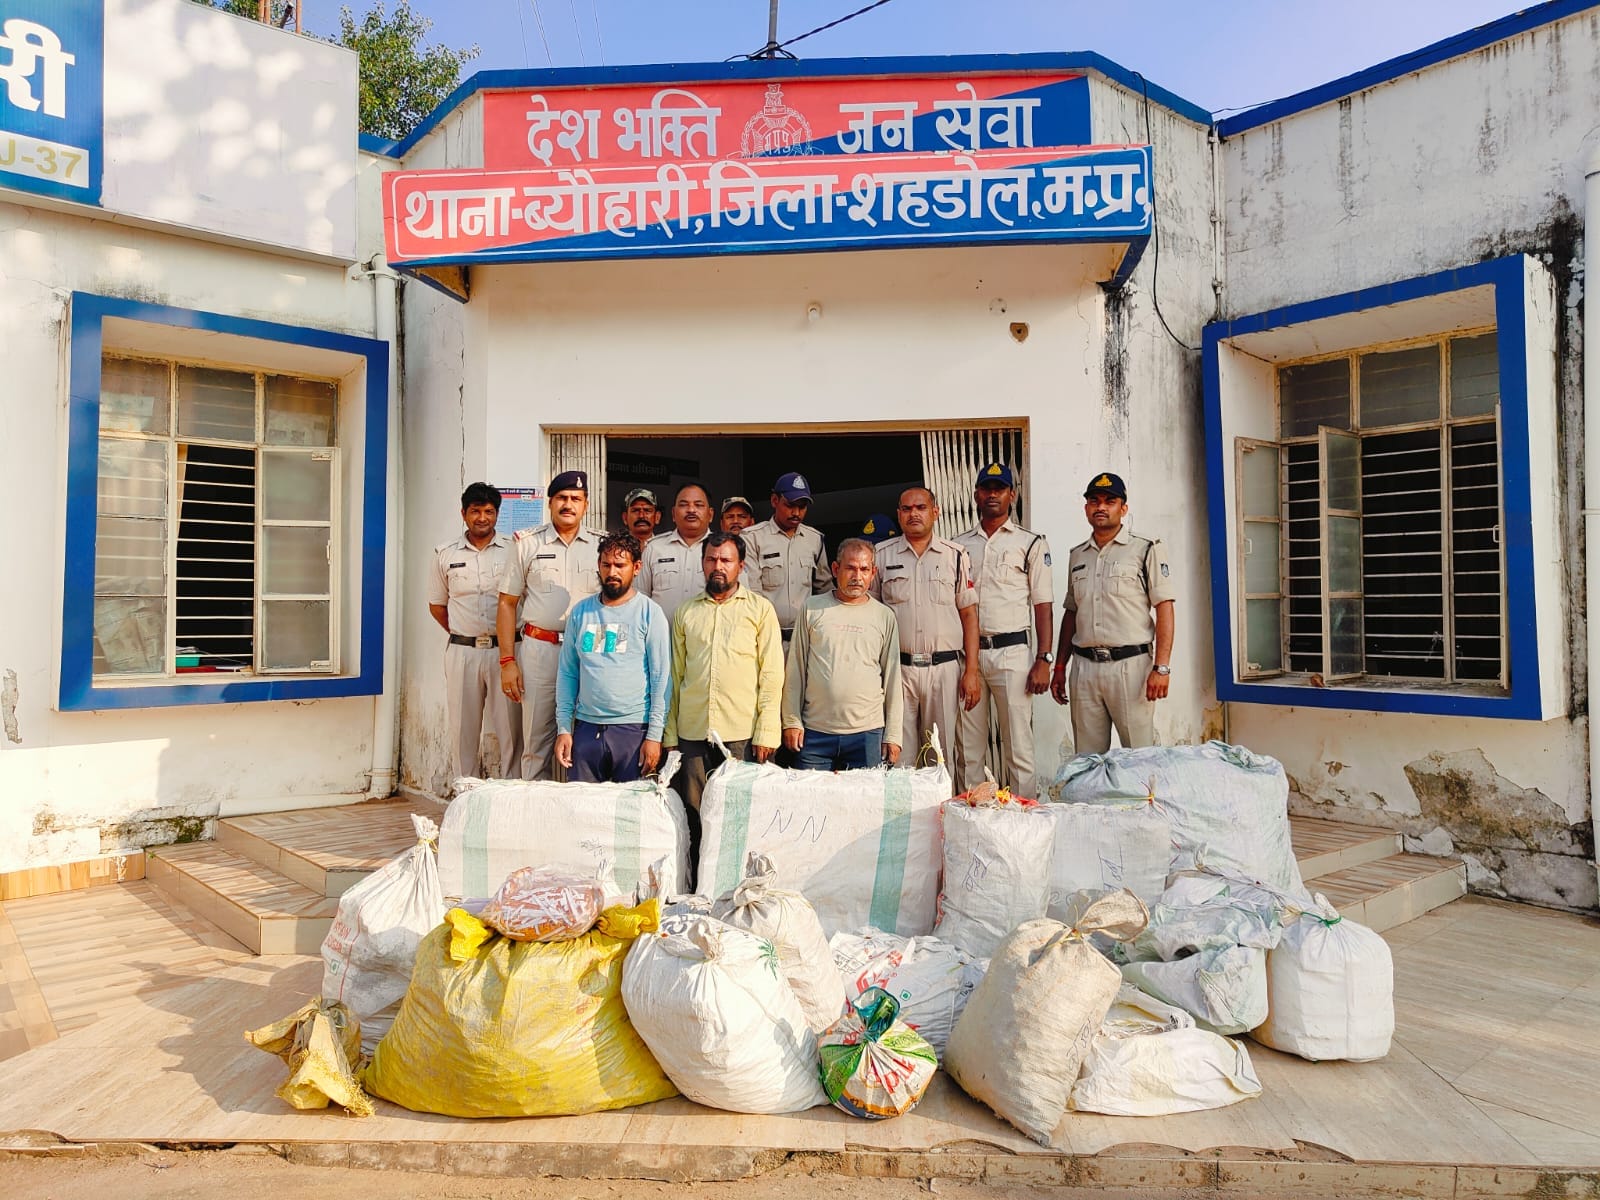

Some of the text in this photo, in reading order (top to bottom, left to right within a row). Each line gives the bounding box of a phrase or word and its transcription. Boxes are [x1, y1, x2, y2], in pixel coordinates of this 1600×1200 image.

[526, 82, 1041, 166] देश भक्ति जन सेवा
